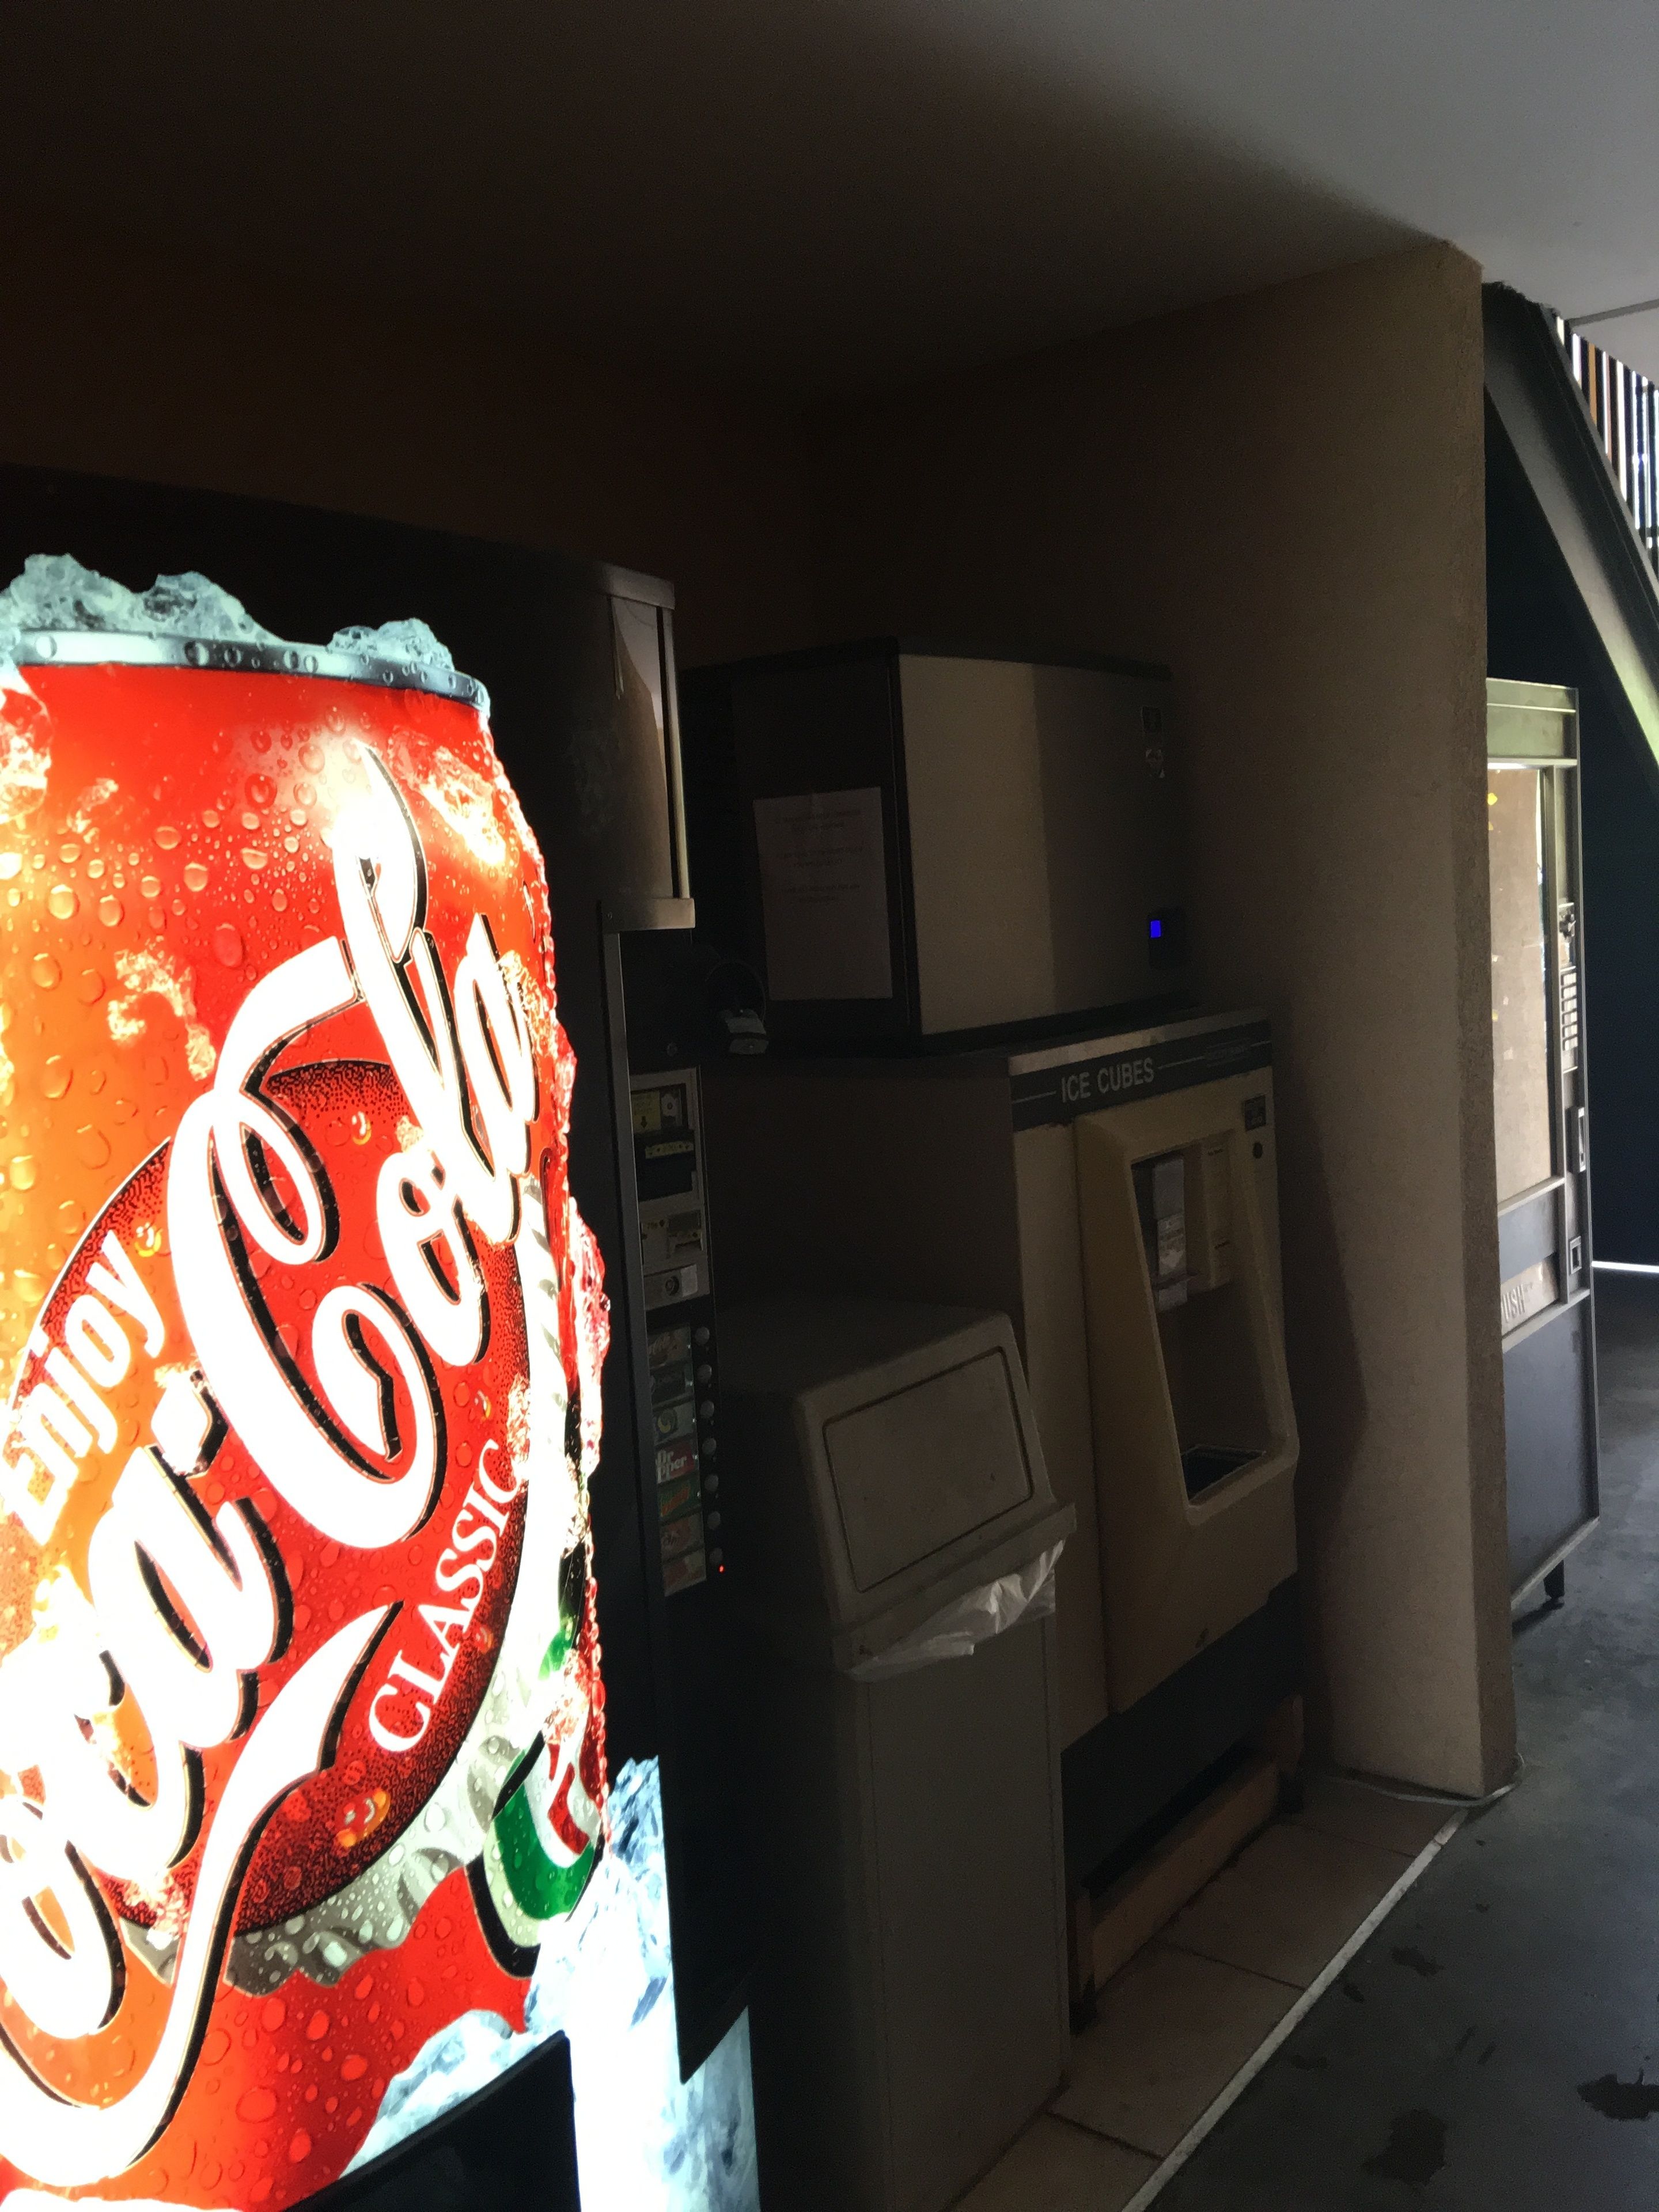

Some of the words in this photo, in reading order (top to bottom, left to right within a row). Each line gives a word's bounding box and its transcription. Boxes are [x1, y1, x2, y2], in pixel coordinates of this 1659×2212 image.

[1061, 1071, 1091, 1103] ICE
[1097, 1057, 1154, 1093] CUBES
[0, 1229, 164, 1546] Enjoy
[1501, 1283, 1525, 1324] USH
[0, 740, 543, 2186] oca-Cola
[369, 1438, 521, 1752] CLASSIC
